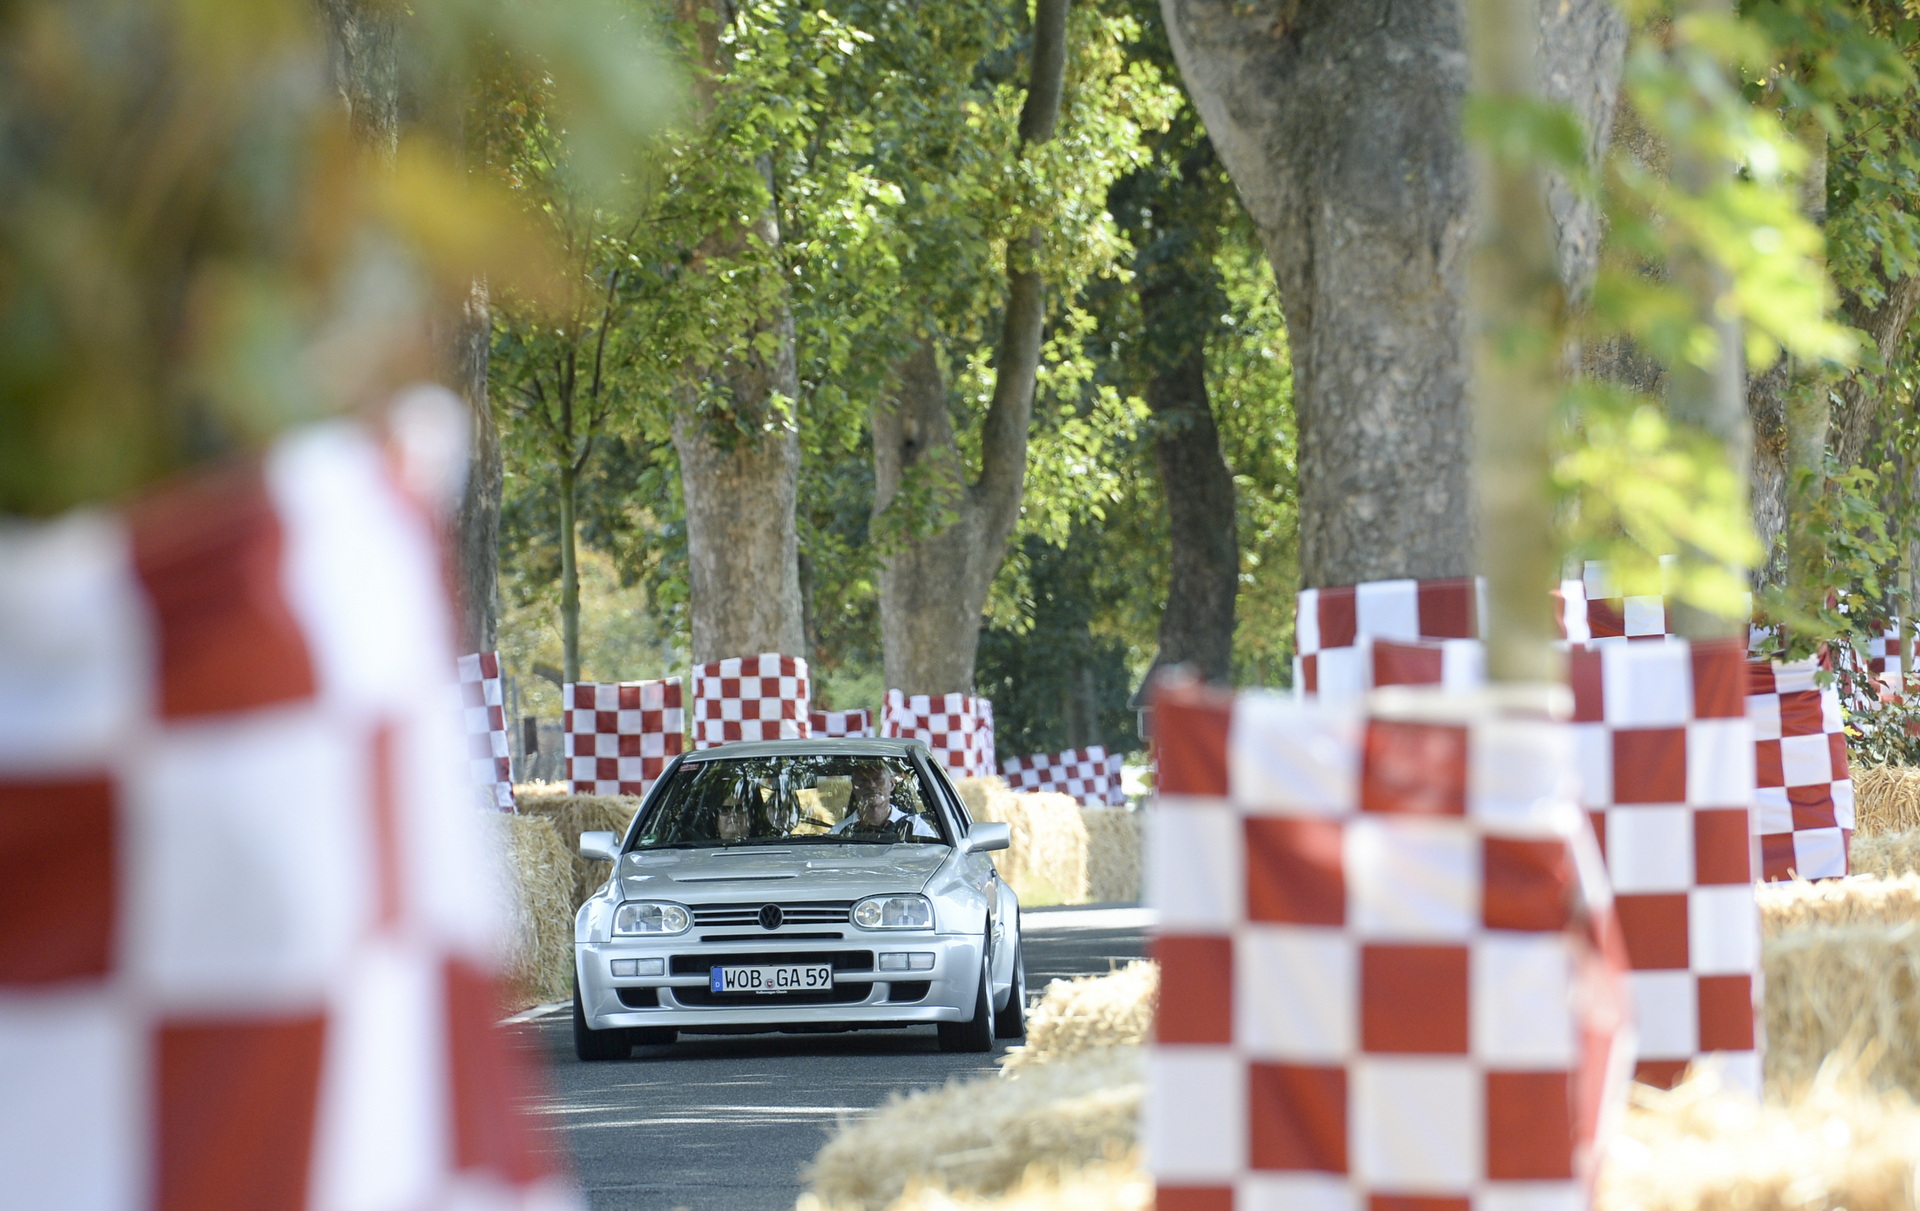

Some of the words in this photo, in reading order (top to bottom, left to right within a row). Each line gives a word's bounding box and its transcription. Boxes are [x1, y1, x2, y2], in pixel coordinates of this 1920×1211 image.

[725, 970, 762, 988] WOB
[776, 968, 801, 987] GA
[806, 968, 829, 987] 59
